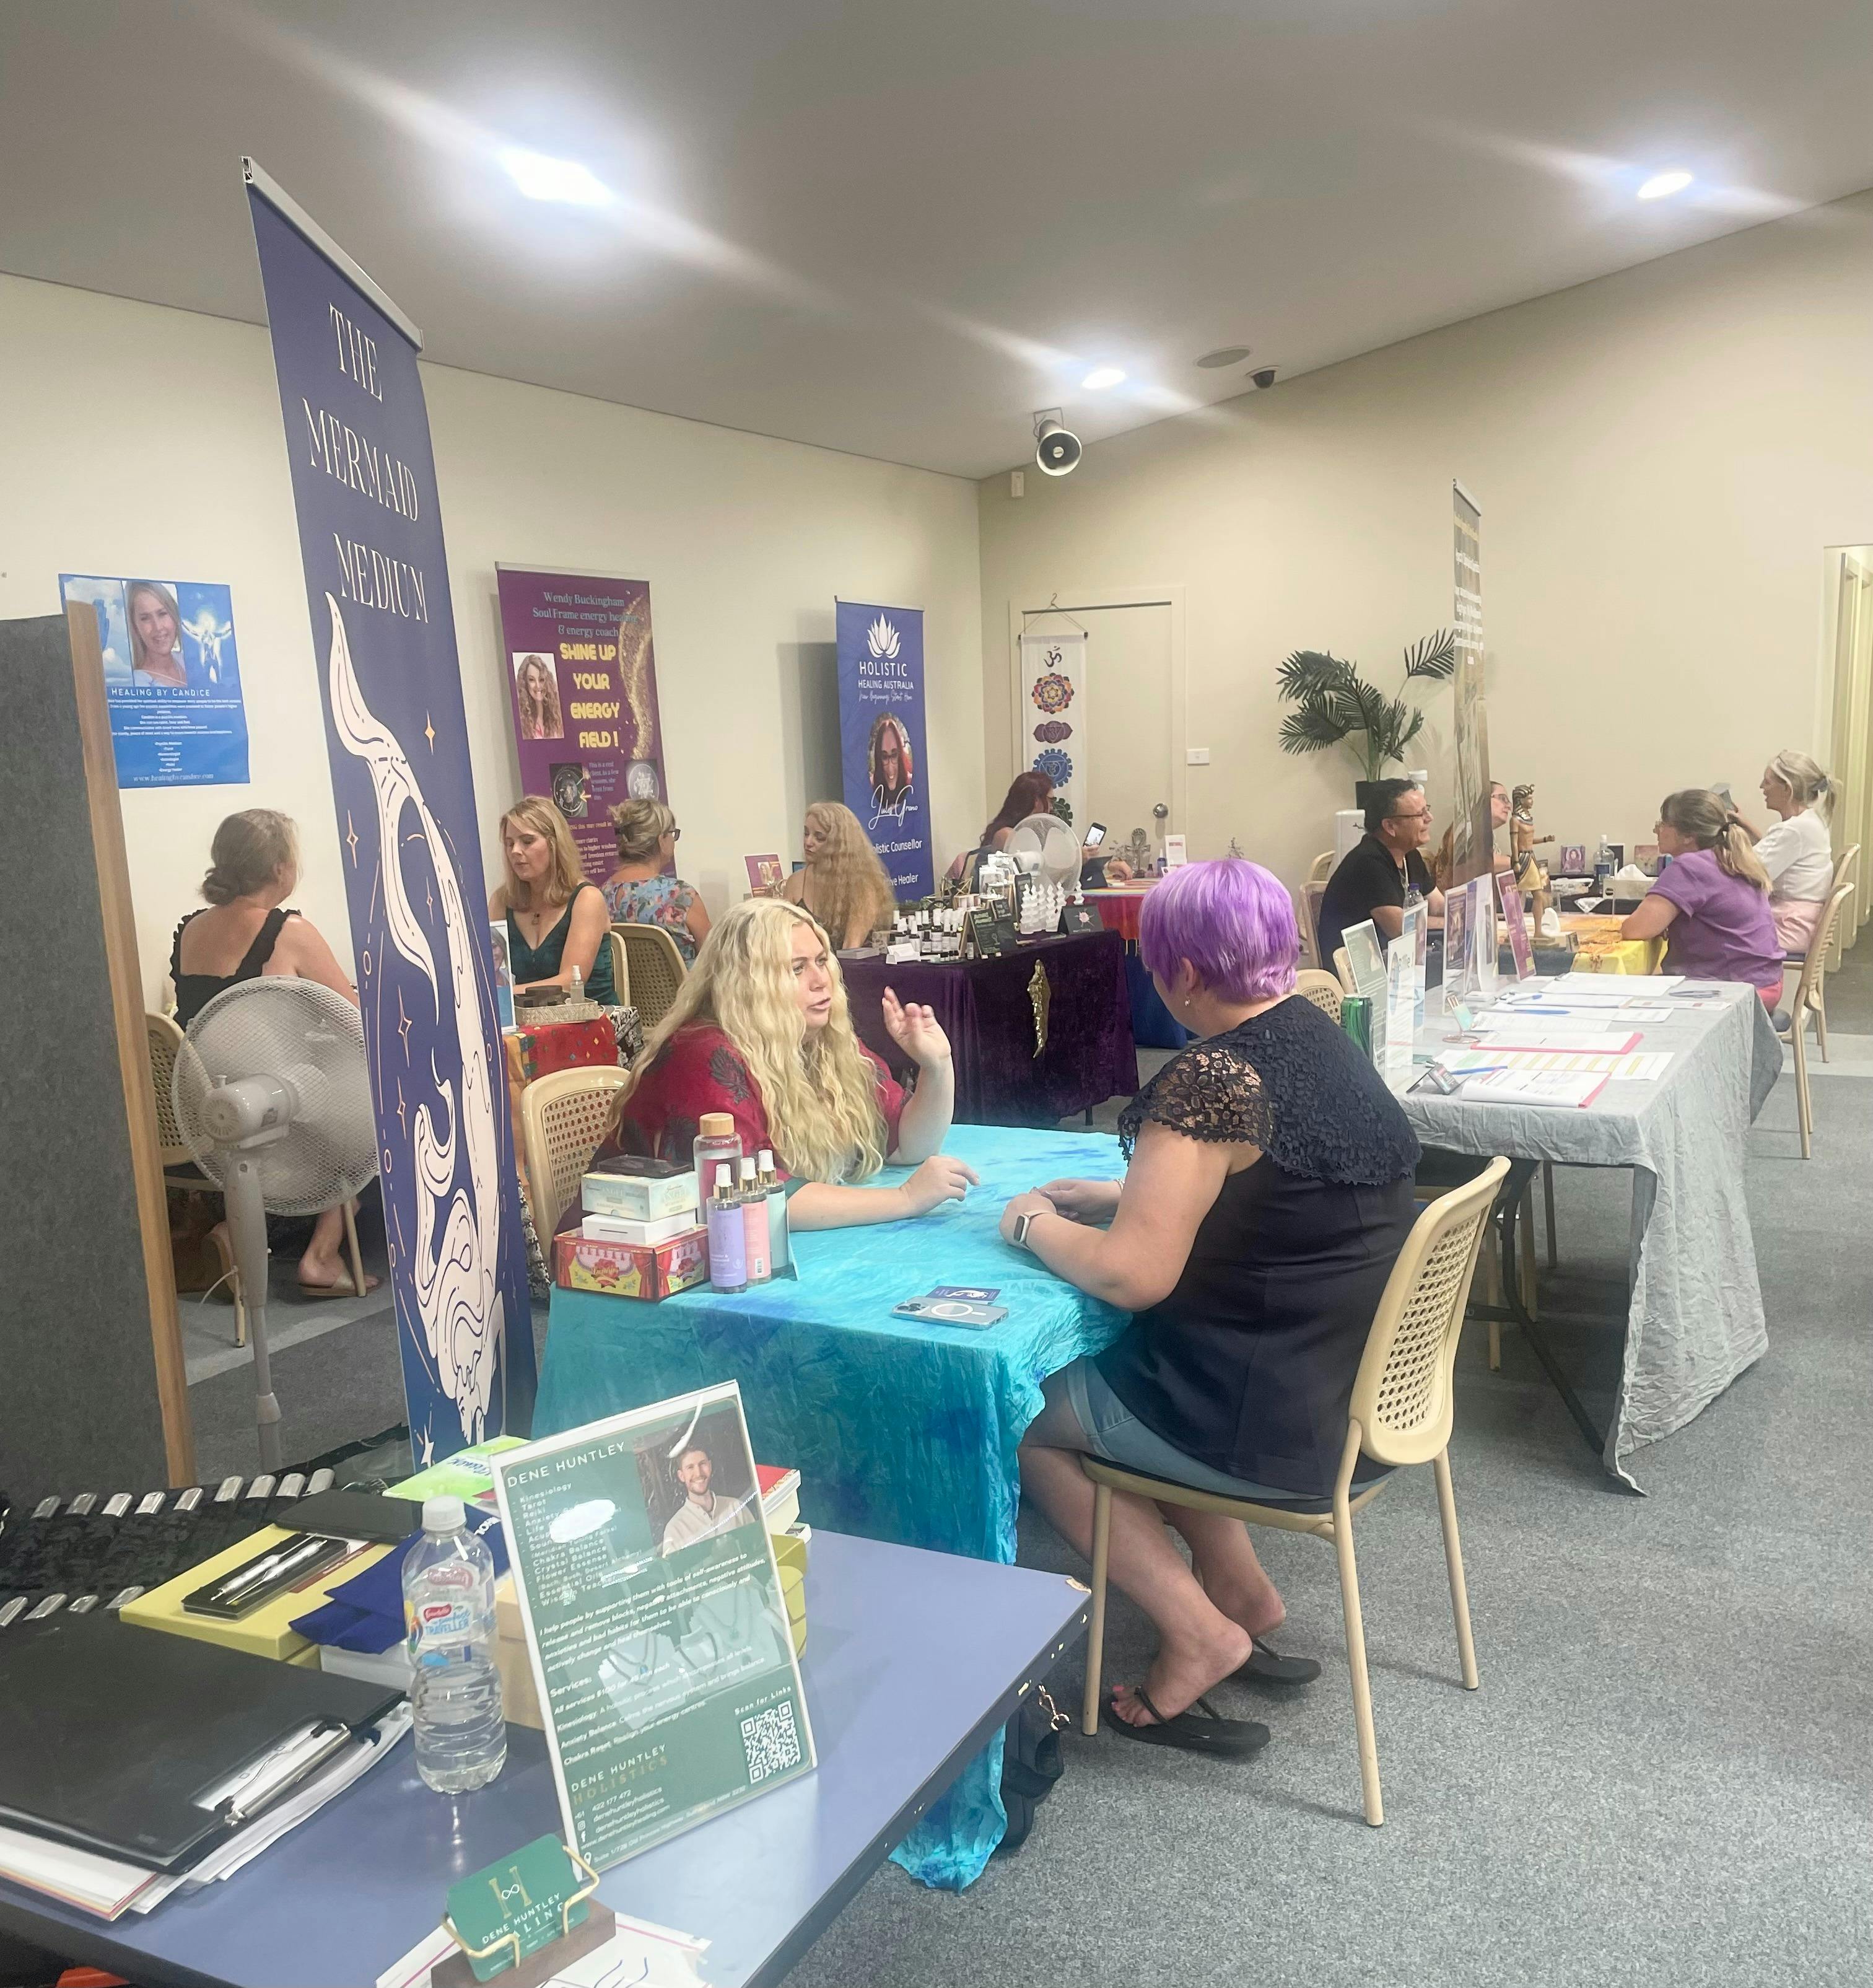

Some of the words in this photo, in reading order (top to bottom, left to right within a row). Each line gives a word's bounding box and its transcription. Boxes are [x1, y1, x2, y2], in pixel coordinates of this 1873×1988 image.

[328, 302, 383, 403] THE
[302, 398, 418, 522] MERMAID
[333, 532, 429, 624] MEDIUM
[543, 592, 573, 605] Wendy
[575, 595, 625, 608] Buckingham
[533, 608, 552, 618] Soul
[553, 609, 579, 620] Frame
[580, 612, 608, 623] energy
[558, 624, 565, 634] &
[567, 628, 593, 639] energy
[595, 626, 619, 637] coach
[559, 643, 597, 661] SHINE
[598, 644, 617, 661] UP
[859, 661, 907, 677] HOLISTIC
[573, 673, 610, 690] YOUR
[858, 680, 883, 689] HEALING
[883, 681, 914, 690] AUSTRALIA
[111, 688, 152, 696] HEALING
[157, 688, 167, 696] BY
[172, 688, 210, 696] CANDICE
[570, 703, 619, 719] ENERGY
[579, 731, 611, 748] FIELD
[891, 838, 923, 852] Counsellor
[898, 872, 919, 886] Healer
[507, 1466, 549, 1487] DENE
[556, 1442, 626, 1471] HUNTLEY
[520, 1481, 572, 1504] Kinesiology
[522, 1498, 546, 1510] Tarot
[523, 1507, 545, 1518] Reiki
[525, 1511, 558, 1526] Anxiety
[526, 1524, 544, 1534] Life
[533, 1551, 565, 1566] Chakra
[569, 1537, 603, 1553] Balance
[535, 1558, 568, 1575] Crystal
[571, 1544, 607, 1561] Balance
[536, 1567, 566, 1582] Flower
[539, 1579, 582, 1598] Essential
[585, 1570, 603, 1581] Oils
[541, 1633, 568, 1649] release
[569, 1627, 584, 1639] and
[584, 1616, 611, 1632] remove
[611, 1607, 635, 1622] blocks,
[665, 1579, 707, 1600] attachments,
[708, 1567, 735, 1583] negative
[736, 1556, 765, 1572] attitudes,
[544, 1624, 559, 1635] help
[559, 1614, 584, 1629] people
[585, 1610, 594, 1619] by
[595, 1596, 631, 1615] supporting
[632, 1589, 649, 1600] them
[650, 1583, 665, 1593] with
[666, 1576, 683, 1587] tools
[692, 1554, 739, 1577] self-awareness
[544, 1643, 577, 1660] anxieties
[578, 1637, 592, 1647] and
[593, 1632, 606, 1641] bad
[607, 1622, 629, 1636] habits
[629, 1618, 640, 1627] for
[641, 1611, 658, 1622] them
[677, 1598, 691, 1608] able
[701, 1580, 737, 1598] consciously
[738, 1574, 751, 1583] and
[424, 1619, 469, 1636] TRAVELLER
[547, 1656, 576, 1673] actively
[577, 1645, 603, 1660] change
[603, 1640, 616, 1650] and
[616, 1634, 632, 1644] heal
[632, 1618, 671, 1638] themselves.
[707, 1676, 719, 1686] and
[553, 1706, 564, 1715] All
[565, 1692, 595, 1710] services
[735, 1702, 753, 1715] Scan
[756, 1696, 767, 1704] for
[770, 1684, 792, 1699] Links
[564, 1751, 589, 1766] Chakra
[656, 1711, 679, 1726] energy
[571, 1771, 604, 1792] DENE
[610, 1744, 665, 1774] HUNTLEY
[574, 1755, 667, 1805] HOLISTICS
[482, 1923, 510, 1945] DENE
[513, 1893, 560, 1925] HUNTLEY
